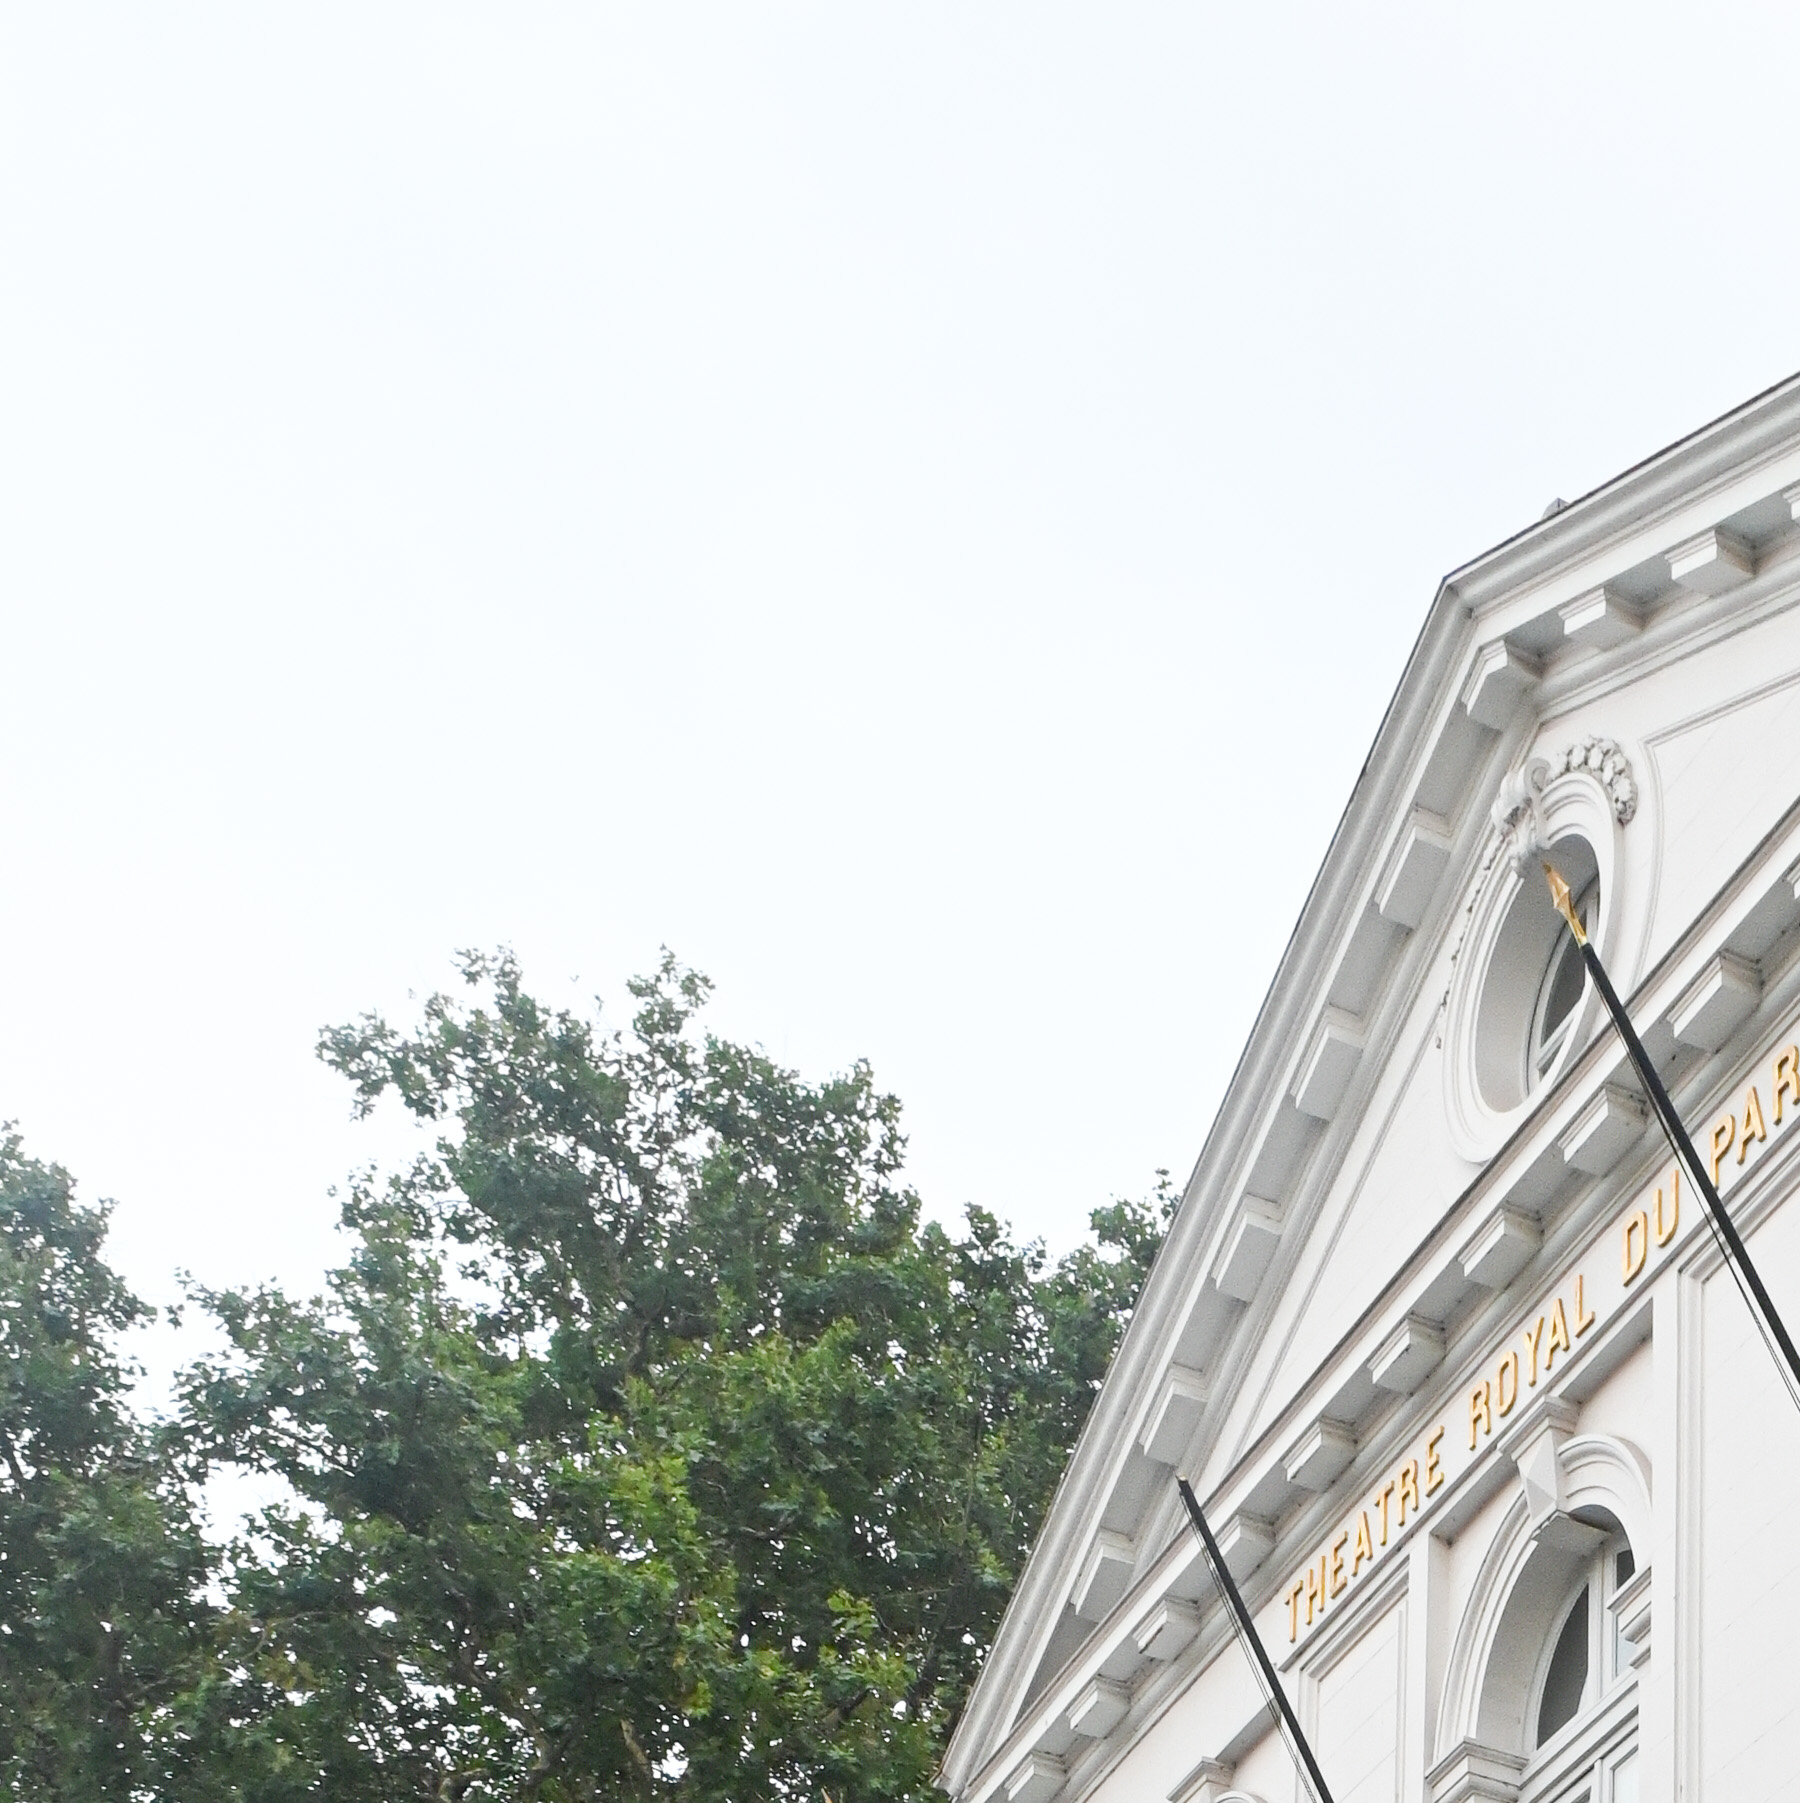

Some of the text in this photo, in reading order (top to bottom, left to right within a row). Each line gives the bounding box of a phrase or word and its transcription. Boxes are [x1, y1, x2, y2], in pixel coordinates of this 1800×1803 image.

[1284, 1424, 1445, 1643] THEATRE
[1468, 1274, 1596, 1450] ROYAL
[1622, 1169, 1681, 1287] DU
